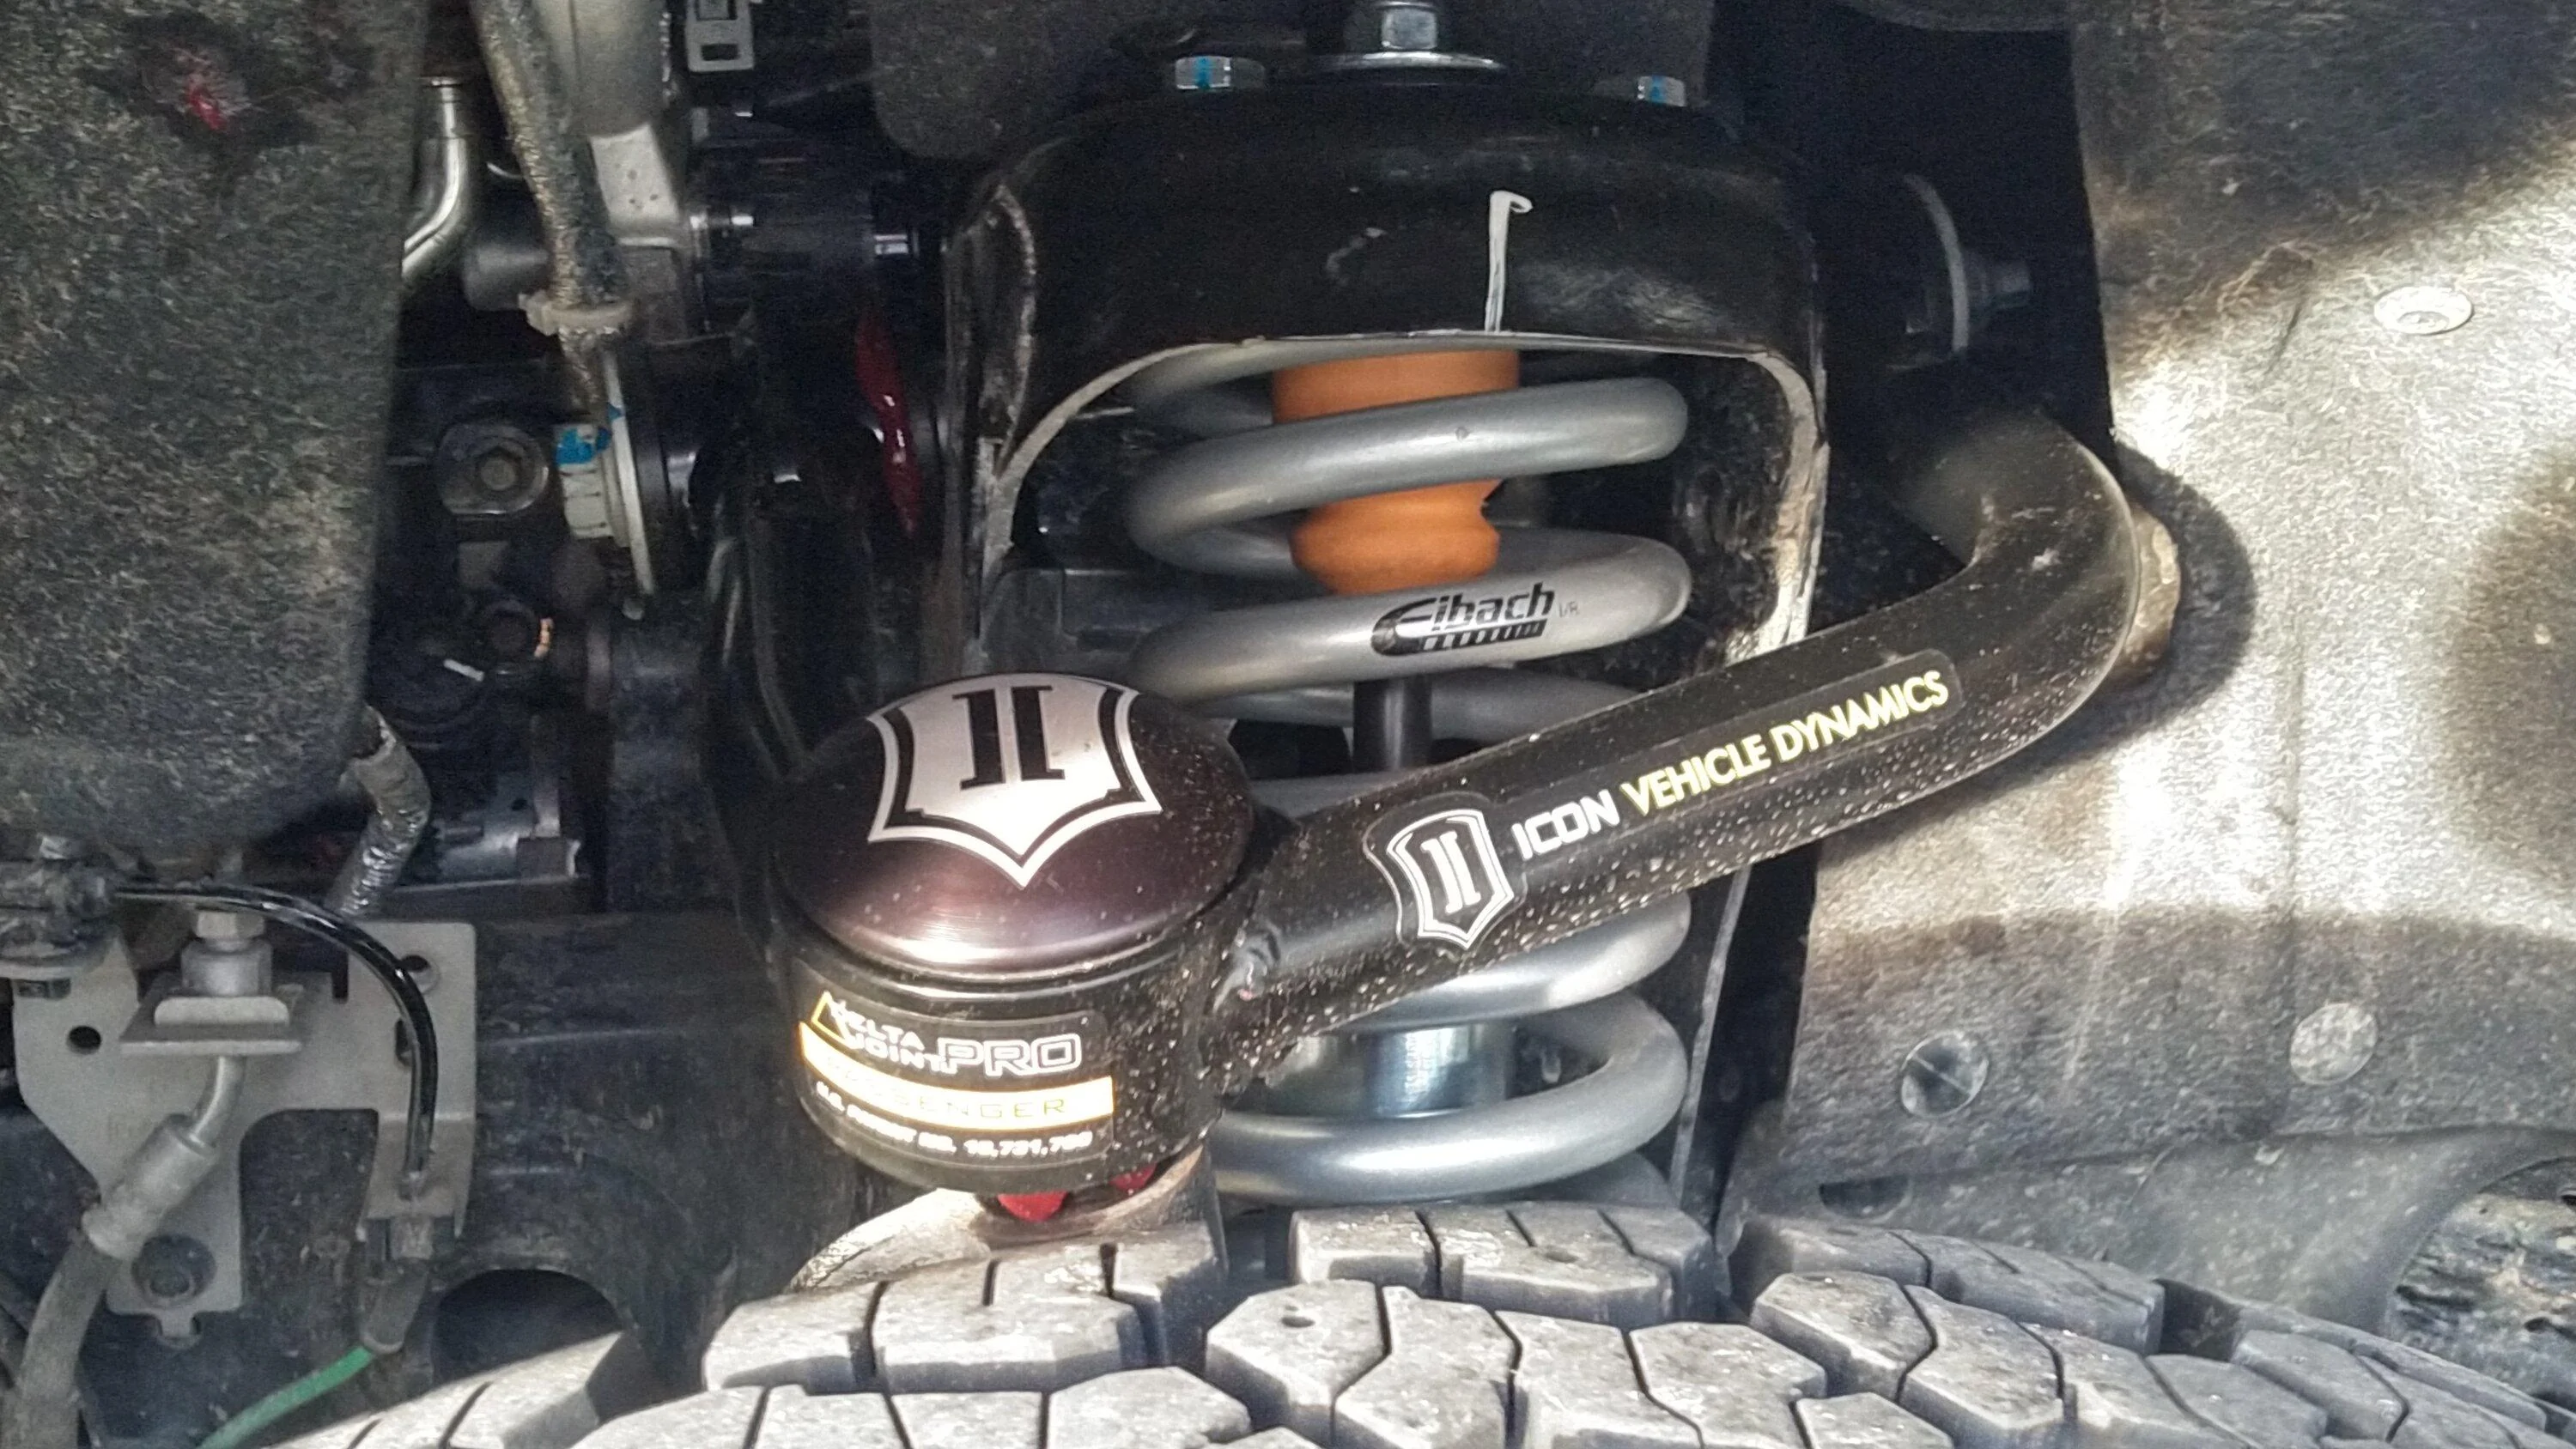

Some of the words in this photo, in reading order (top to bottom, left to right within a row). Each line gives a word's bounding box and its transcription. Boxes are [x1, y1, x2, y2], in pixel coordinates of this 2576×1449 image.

[1371, 581, 1555, 656] Eibach
[1511, 789, 1620, 859] ICON
[1620, 734, 1772, 817] VEHICLE
[1769, 670, 1950, 763] DYNAMICS
[936, 1033, 1083, 1076] PRO
